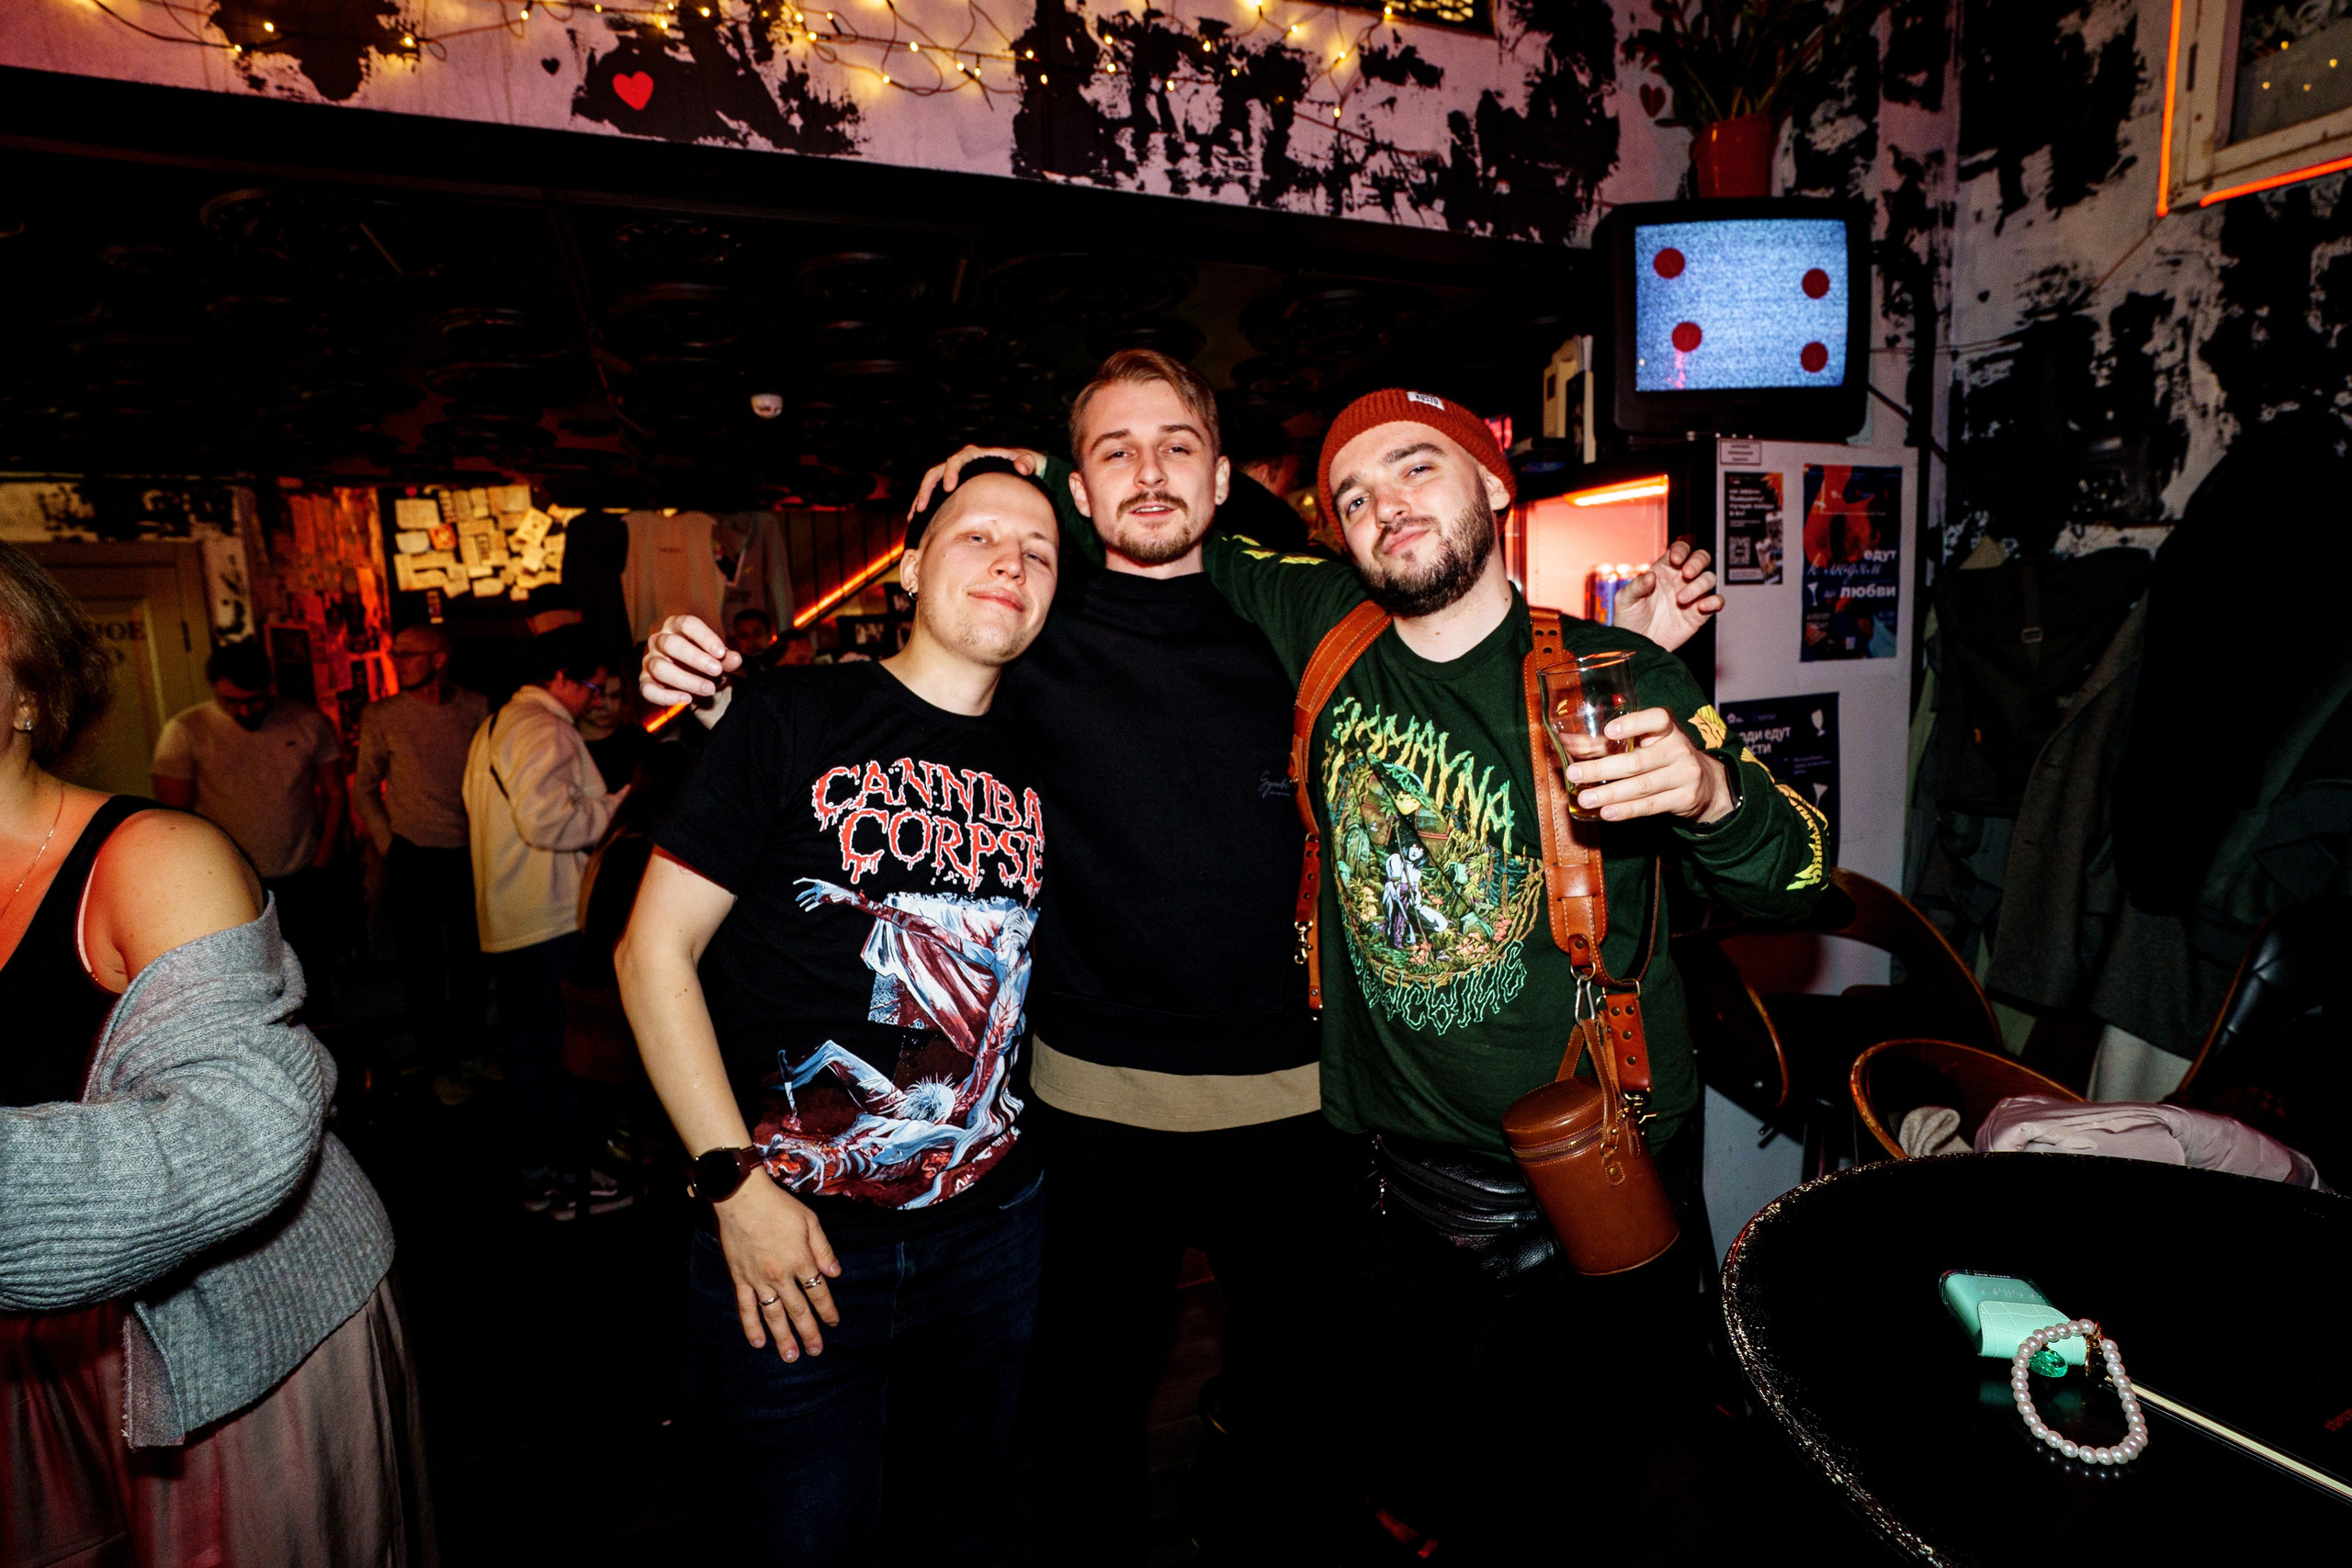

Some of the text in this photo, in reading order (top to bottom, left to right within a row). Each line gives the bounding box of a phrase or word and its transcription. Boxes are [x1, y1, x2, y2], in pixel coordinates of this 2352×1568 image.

[1863, 549, 1897, 563] едут
[1839, 582, 1897, 599] любви
[812, 757, 1045, 852] CANNIBA
[838, 808, 1044, 908] CORPSE
